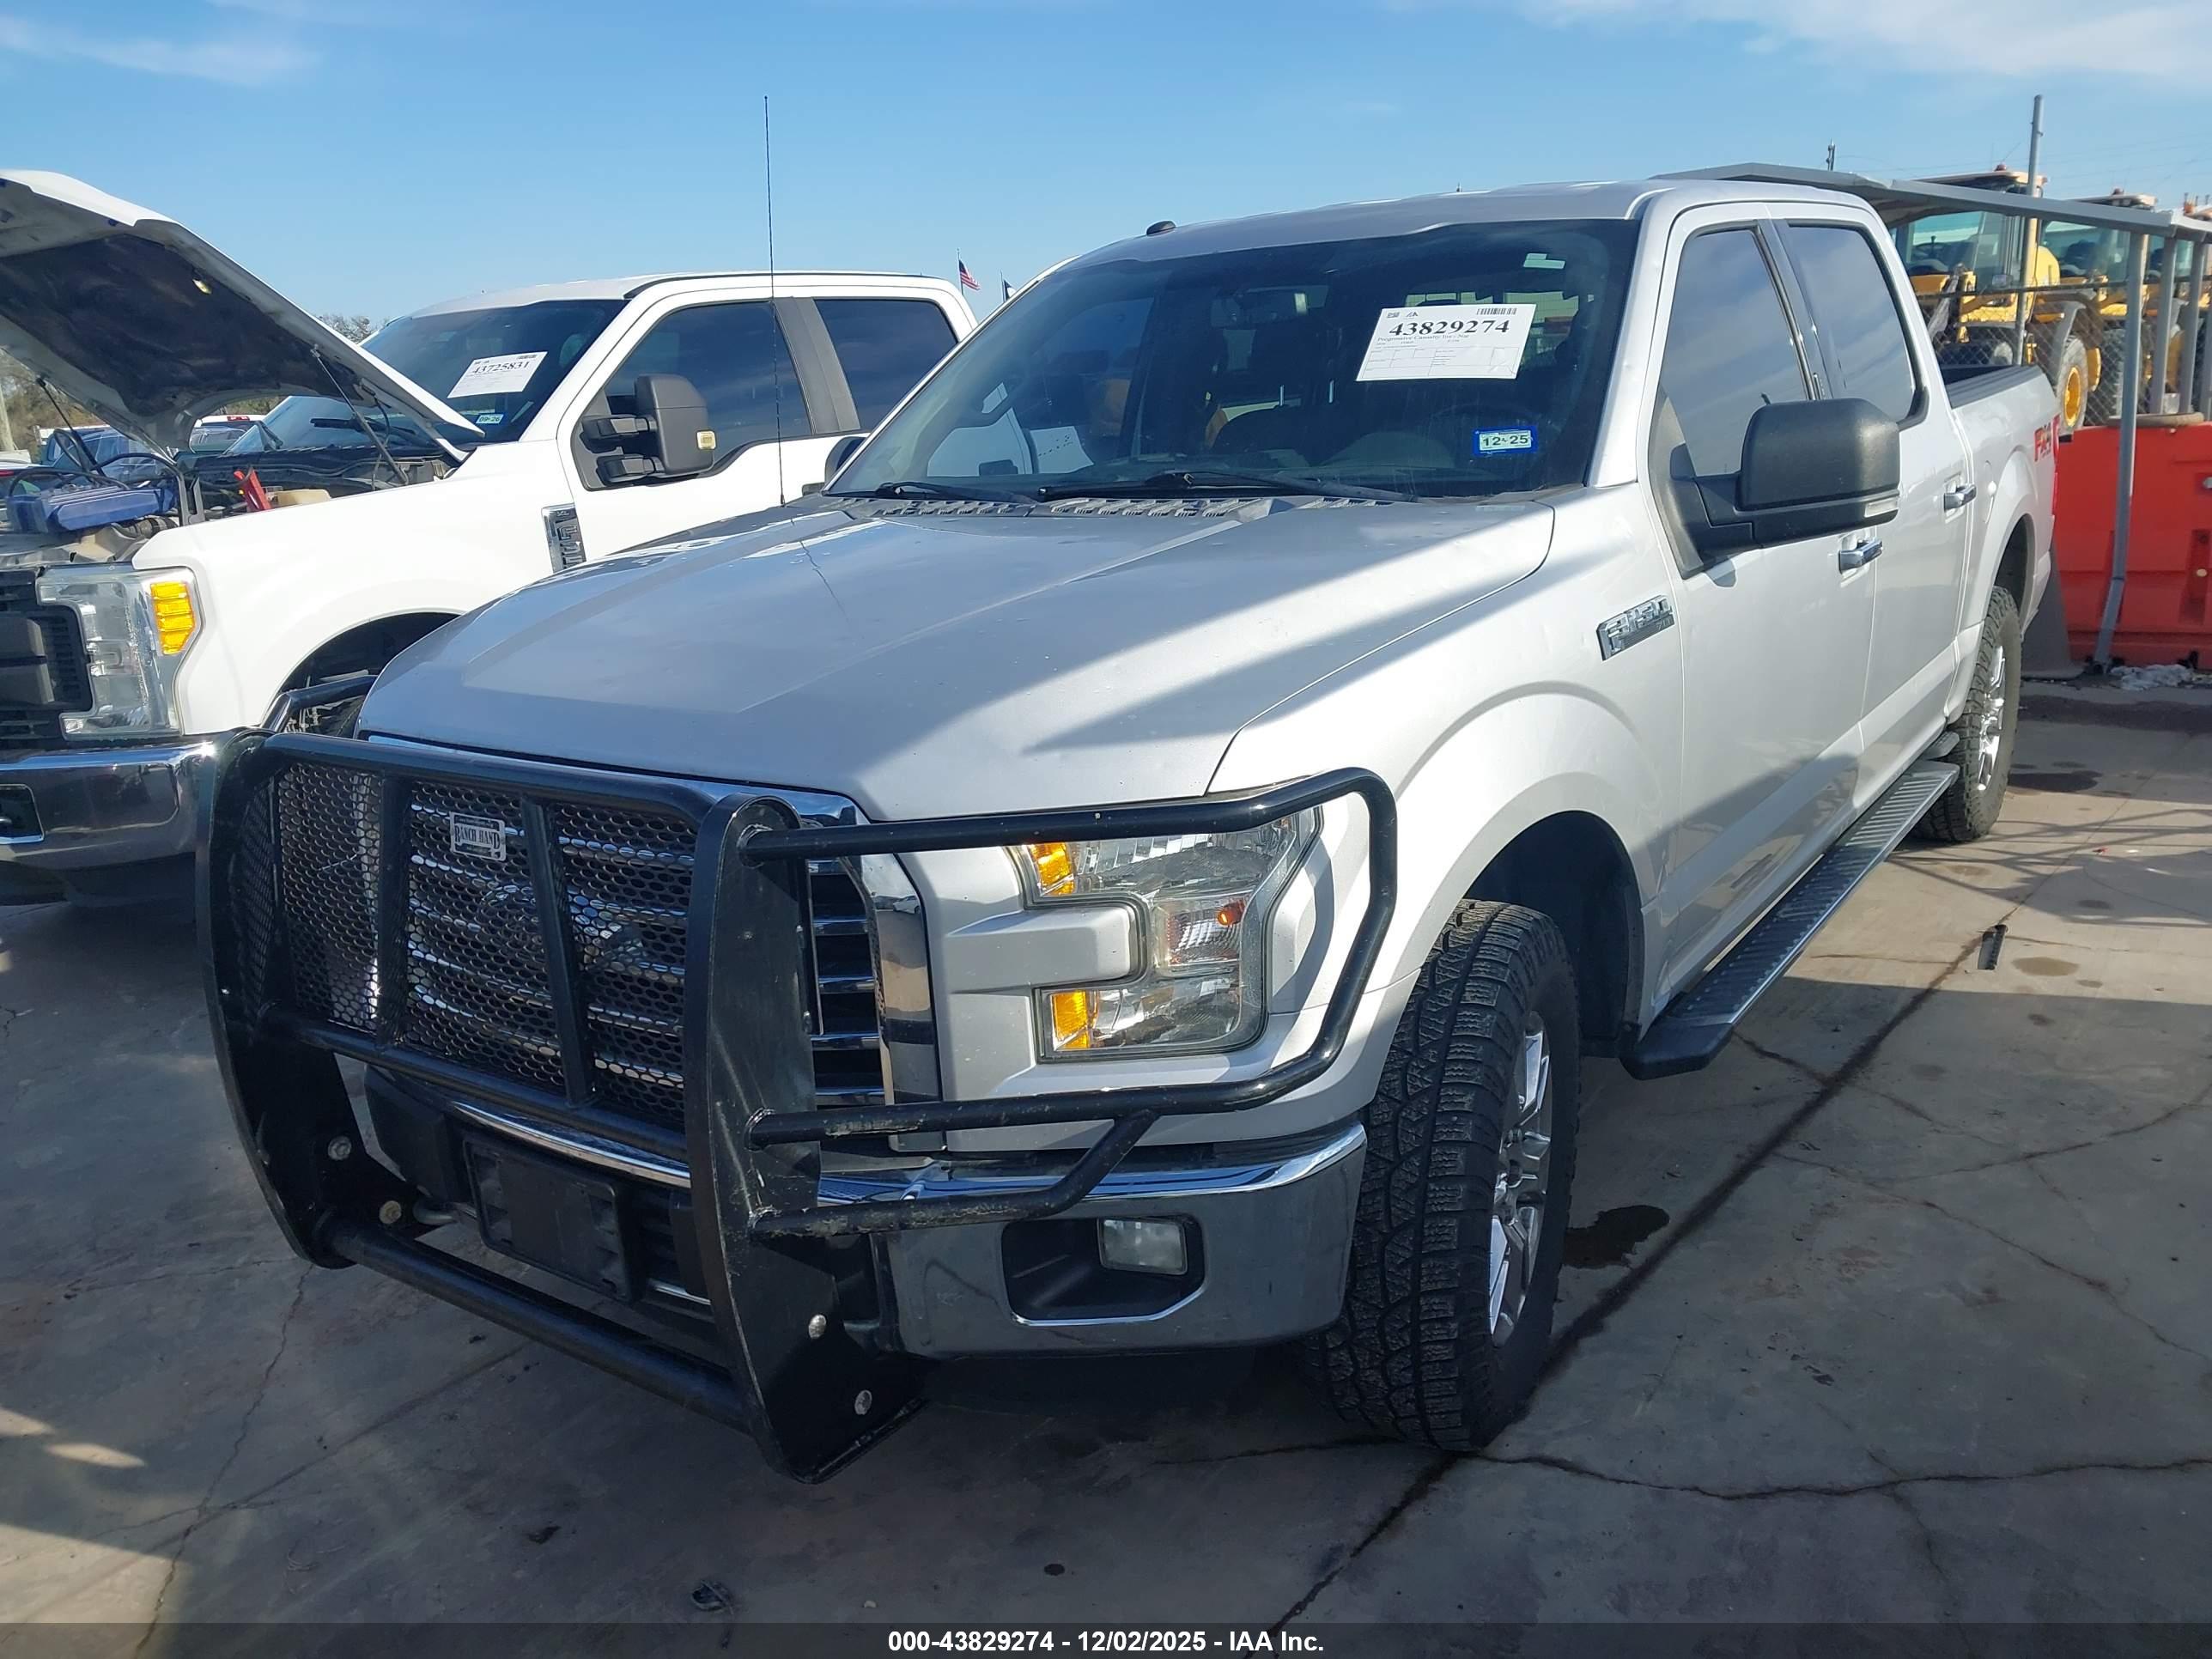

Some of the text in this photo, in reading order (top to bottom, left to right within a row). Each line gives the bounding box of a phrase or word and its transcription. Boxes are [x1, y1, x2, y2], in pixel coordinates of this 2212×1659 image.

[1389, 319, 1509, 335] 43829274
[473, 361, 530, 374] 43725831
[1483, 434, 1528, 446] 12 25
[454, 825, 500, 849] RANCH HAND
